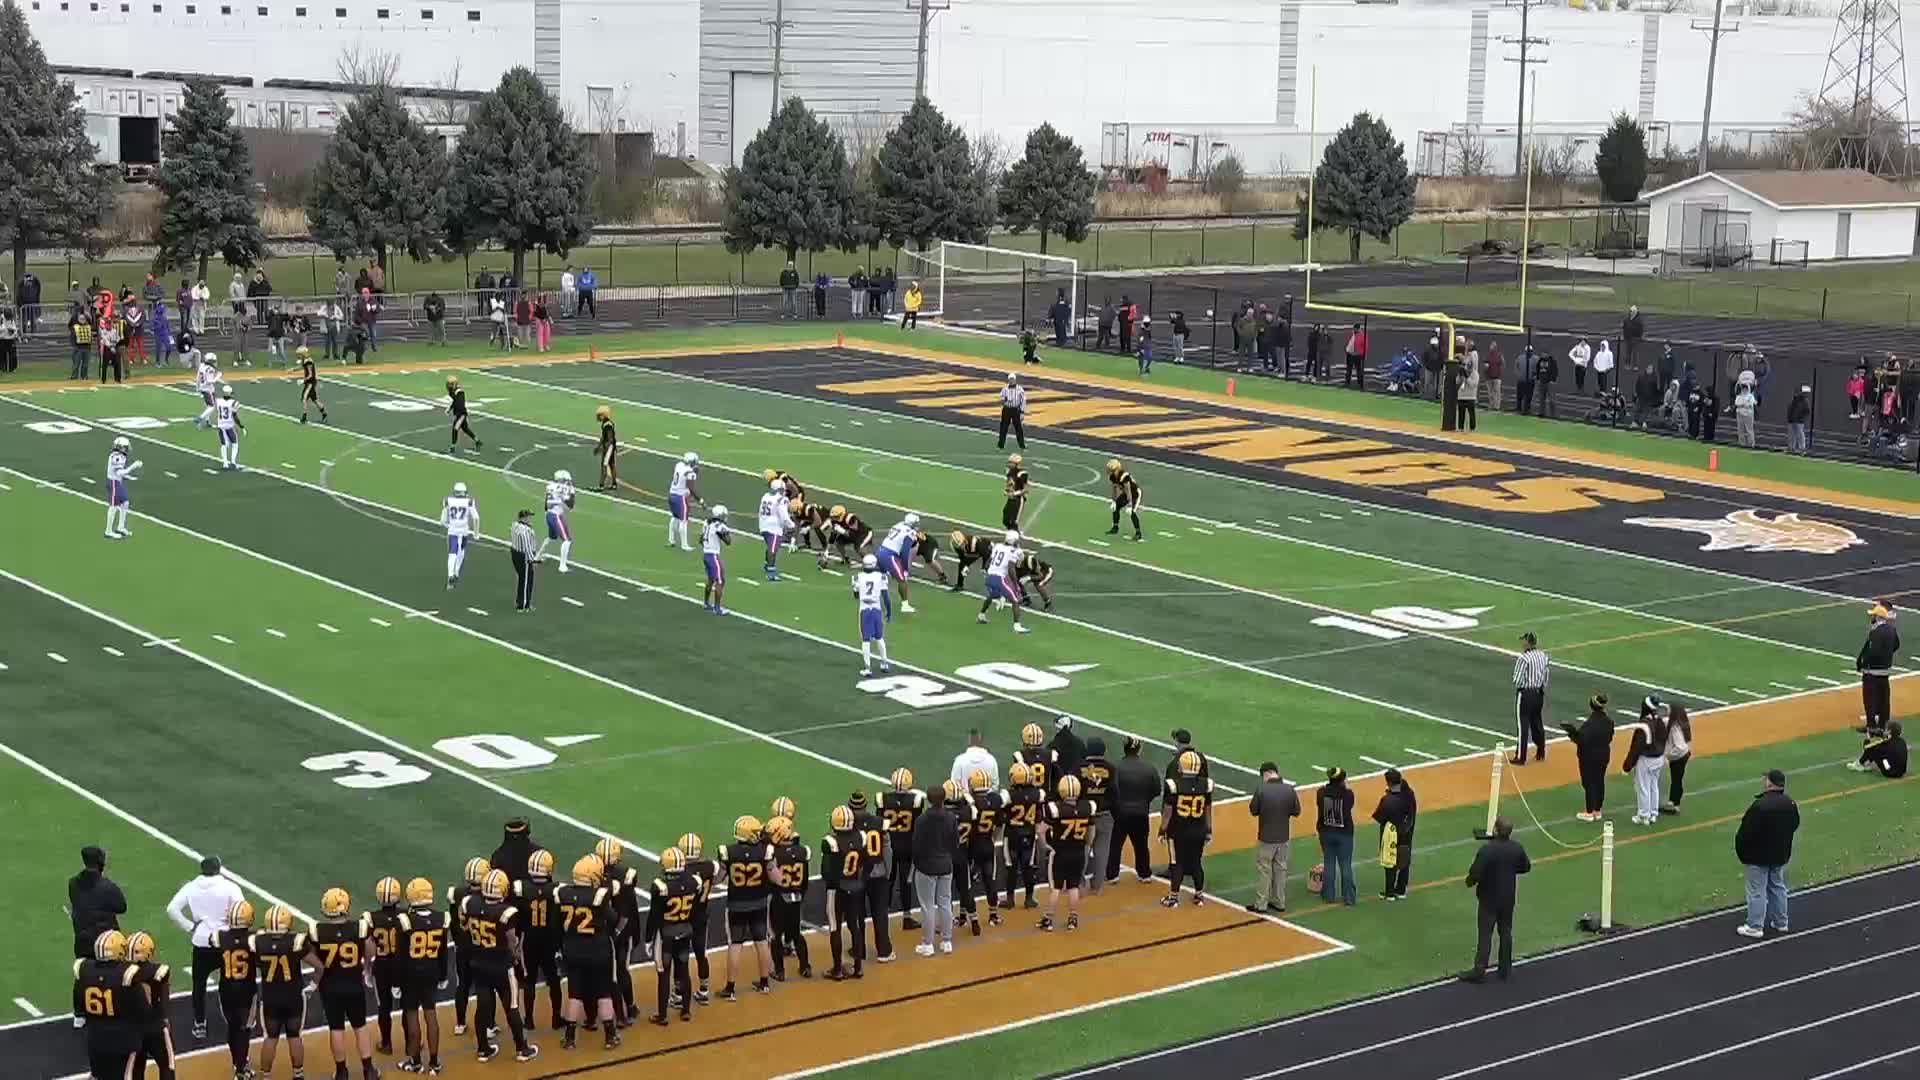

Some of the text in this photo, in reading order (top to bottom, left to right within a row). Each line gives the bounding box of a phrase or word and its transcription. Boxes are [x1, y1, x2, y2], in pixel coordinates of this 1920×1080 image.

[218, 406, 230, 420] 13
[816, 373, 1665, 513] VIKINGS
[865, 581, 874, 596] 7
[856, 662, 1071, 708] 20
[300, 734, 558, 788] 30
[1034, 763, 1045, 785] 8
[1011, 803, 1037, 825] 24
[1176, 795, 1205, 818] 50
[884, 811, 912, 833] 23
[1060, 818, 1089, 841] 75
[866, 830, 881, 857] 0
[730, 863, 763, 887] 62
[843, 851, 860, 877] 0
[530, 899, 548, 927] 11
[560, 905, 595, 935] 72
[664, 895, 696, 921] 25
[409, 929, 443, 959] 85
[468, 917, 498, 949] 65
[223, 948, 249, 980] 16
[260, 953, 292, 983] 71
[320, 942, 359, 969] 79
[85, 986, 115, 1017] 61
